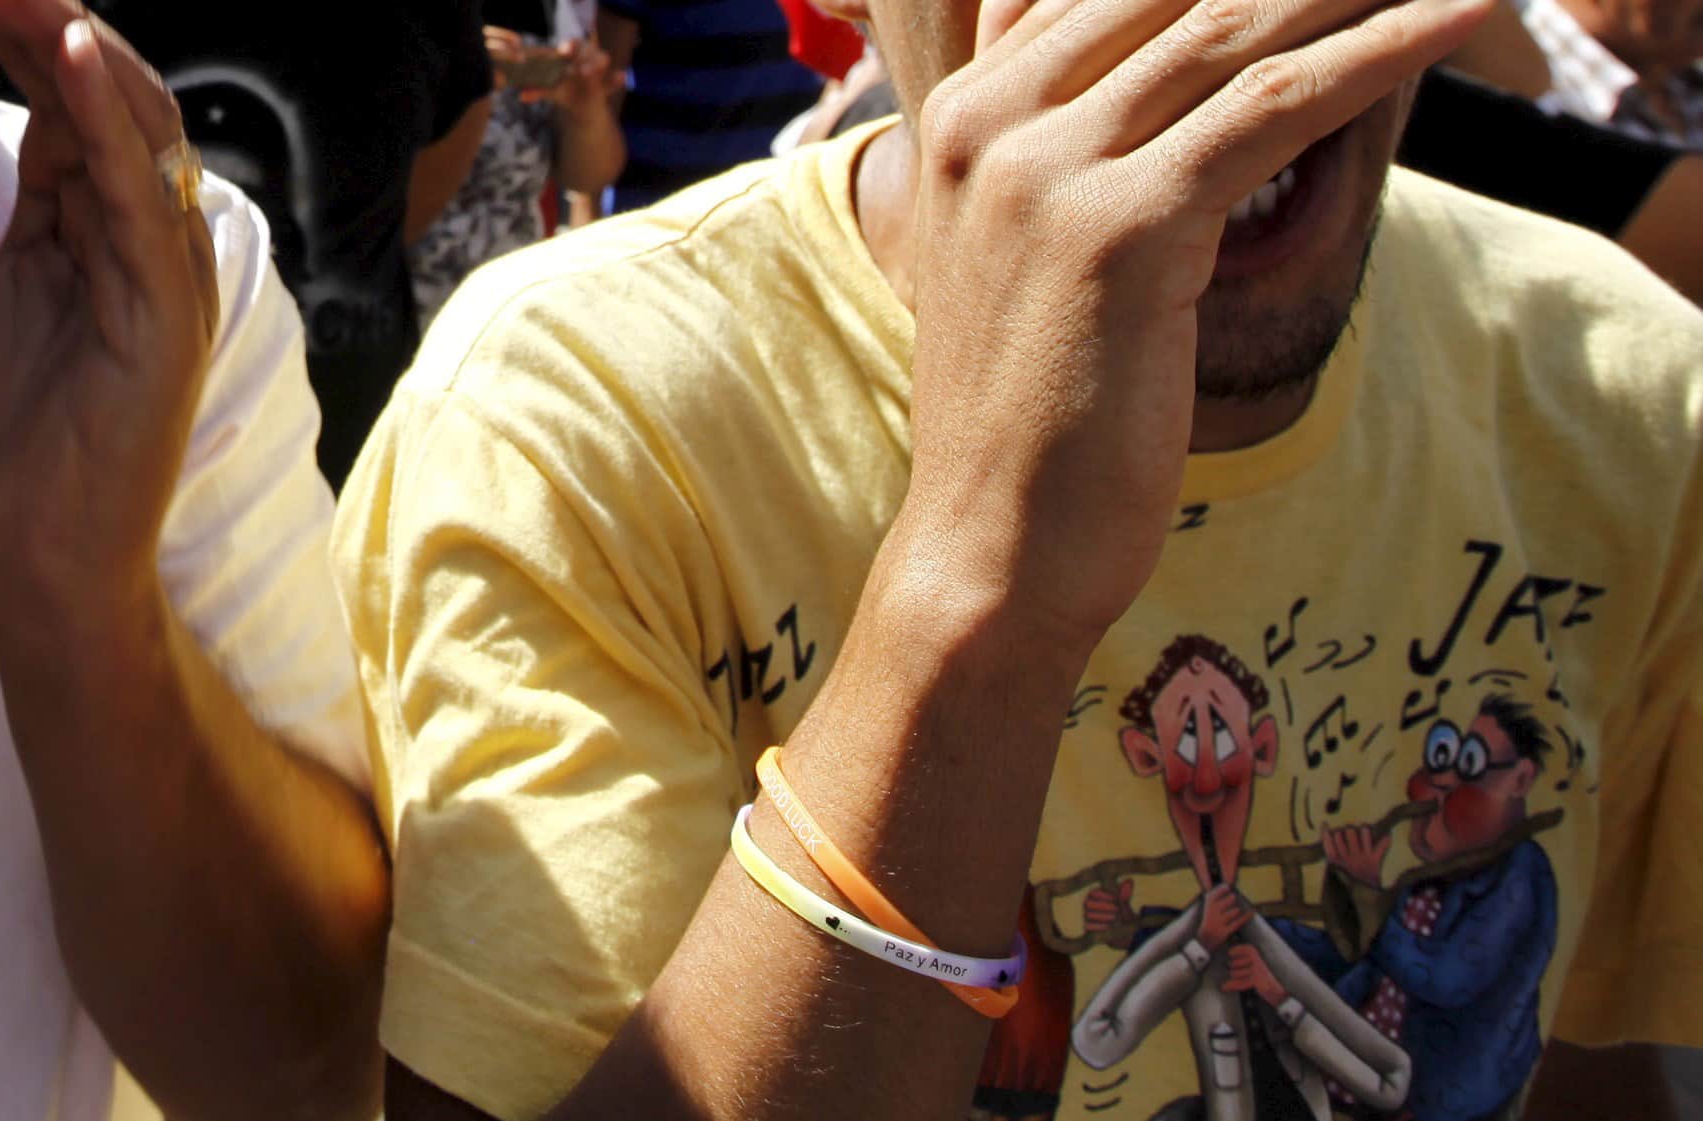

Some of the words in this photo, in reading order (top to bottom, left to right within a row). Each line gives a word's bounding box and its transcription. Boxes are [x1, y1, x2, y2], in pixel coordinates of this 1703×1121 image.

[783, 802, 823, 854] LUCK
[884, 940, 915, 963] Paz
[917, 957, 927, 969] y
[929, 958, 969, 978] Amor
